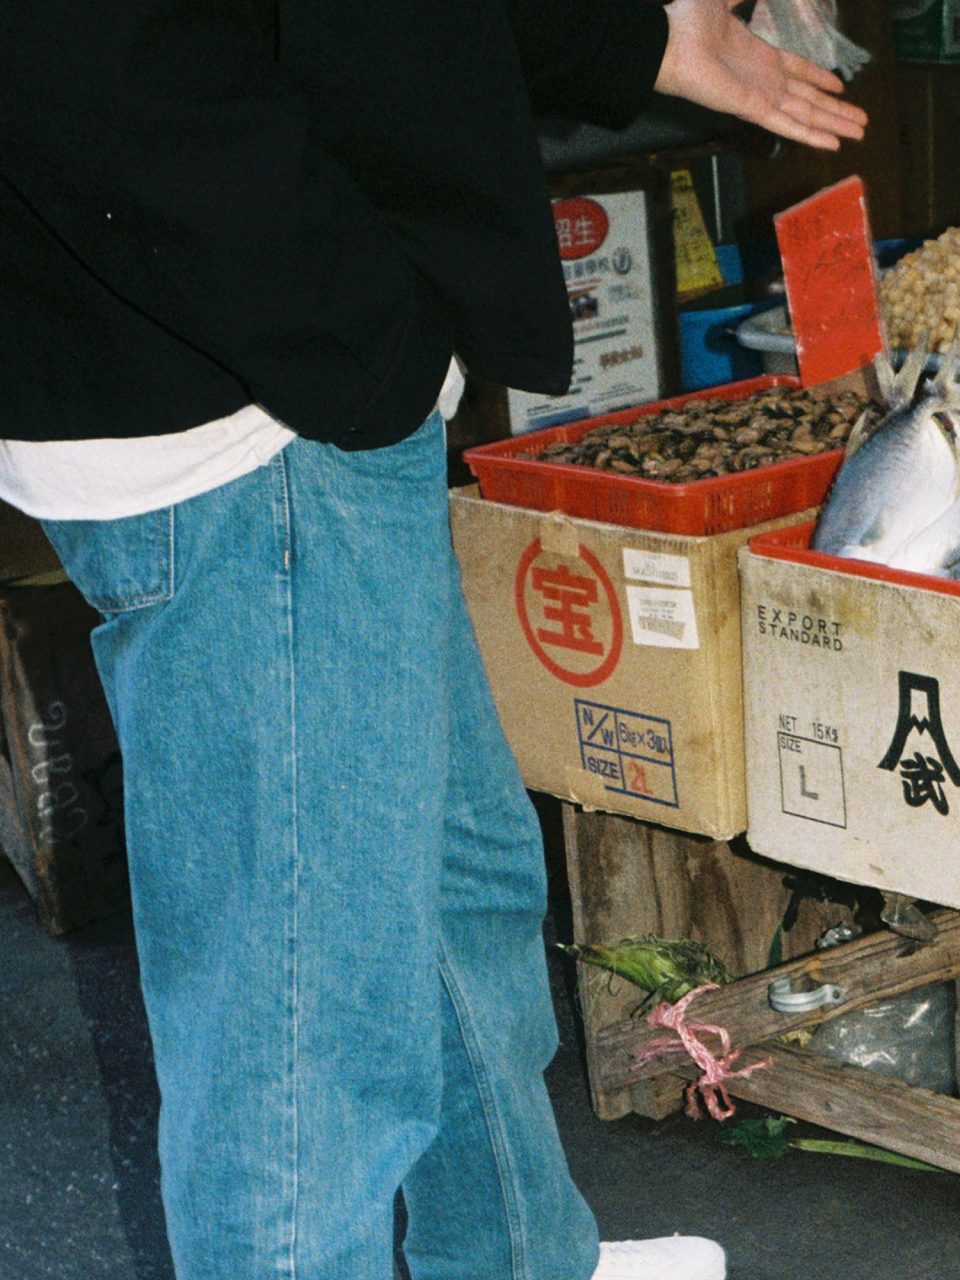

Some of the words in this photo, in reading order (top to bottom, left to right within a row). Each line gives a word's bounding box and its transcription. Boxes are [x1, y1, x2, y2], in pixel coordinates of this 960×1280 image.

[531, 564, 604, 656] 宝
[757, 605, 841, 637] EXPORT
[758, 621, 843, 652] STANDARD
[779, 713, 797, 733] NET
[780, 737, 802, 754] SIZE
[588, 756, 620, 780] SIZE
[628, 761, 654, 795] 2L
[799, 765, 819, 800] L
